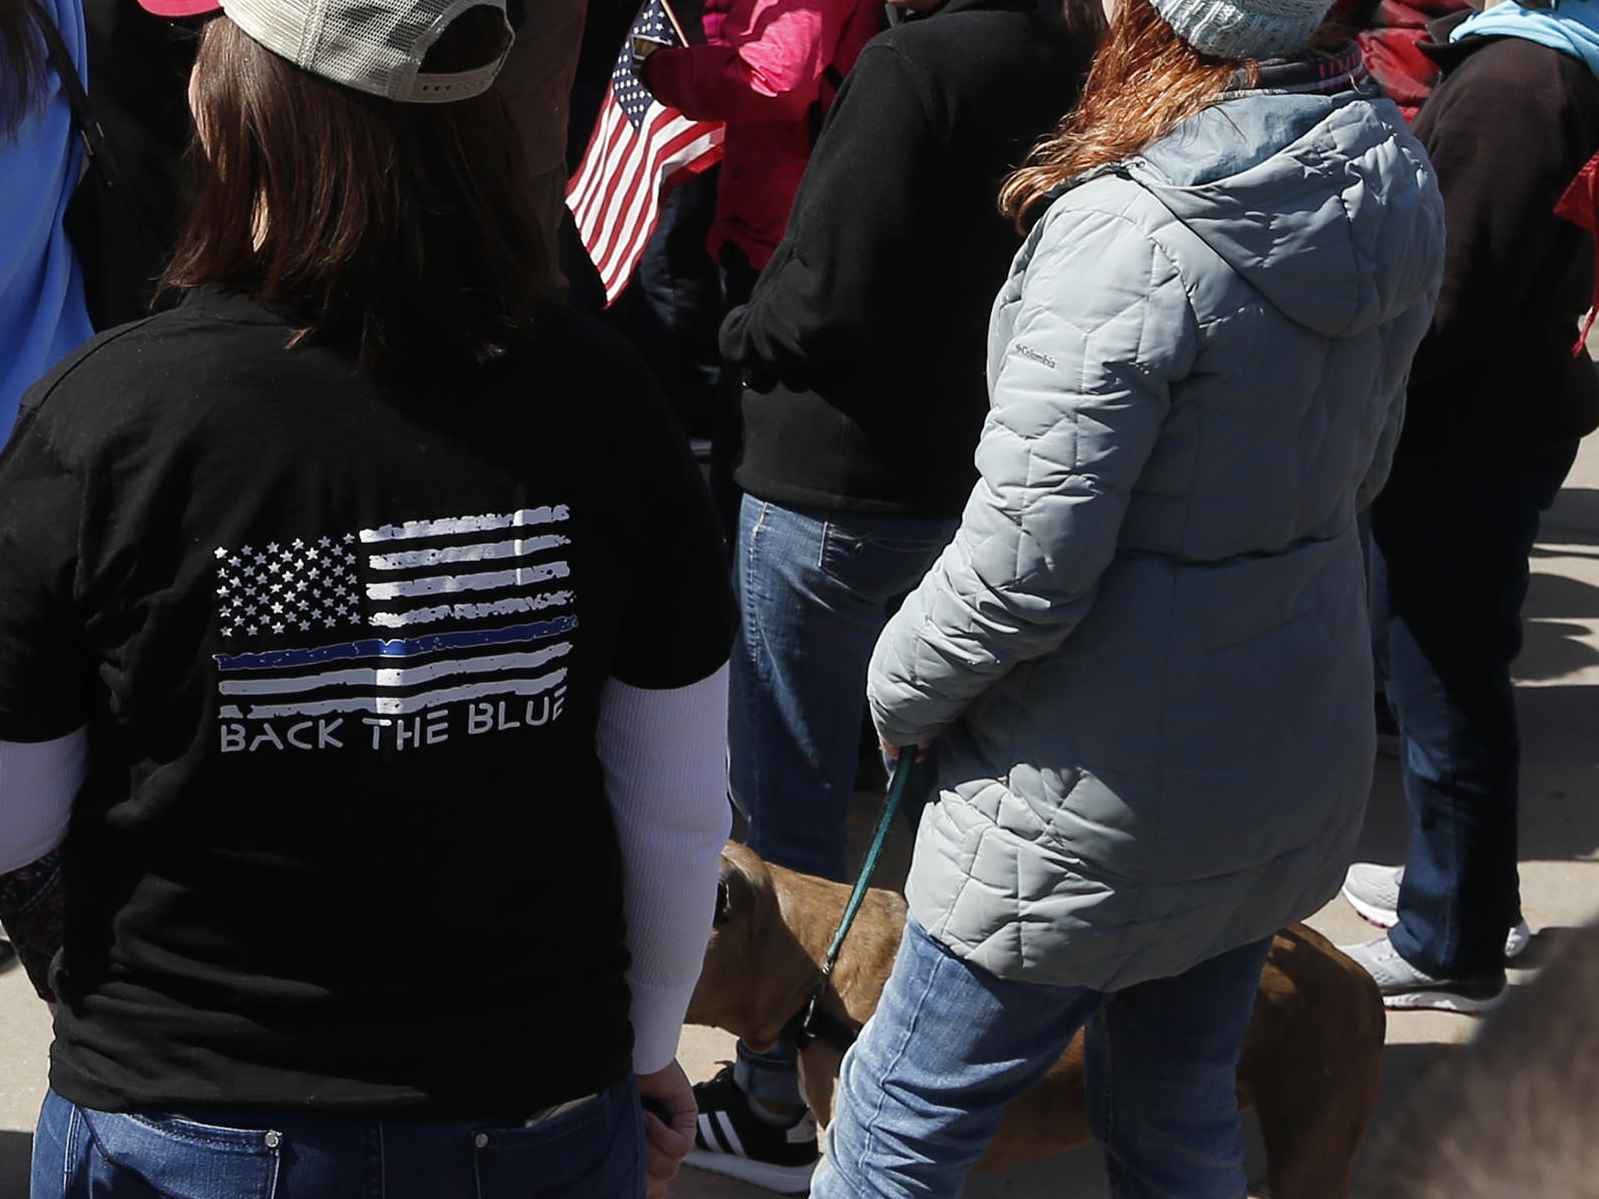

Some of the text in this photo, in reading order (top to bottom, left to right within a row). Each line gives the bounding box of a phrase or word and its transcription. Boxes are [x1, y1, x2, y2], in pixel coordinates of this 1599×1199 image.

[220, 685, 568, 753] BACK THE BLUE
